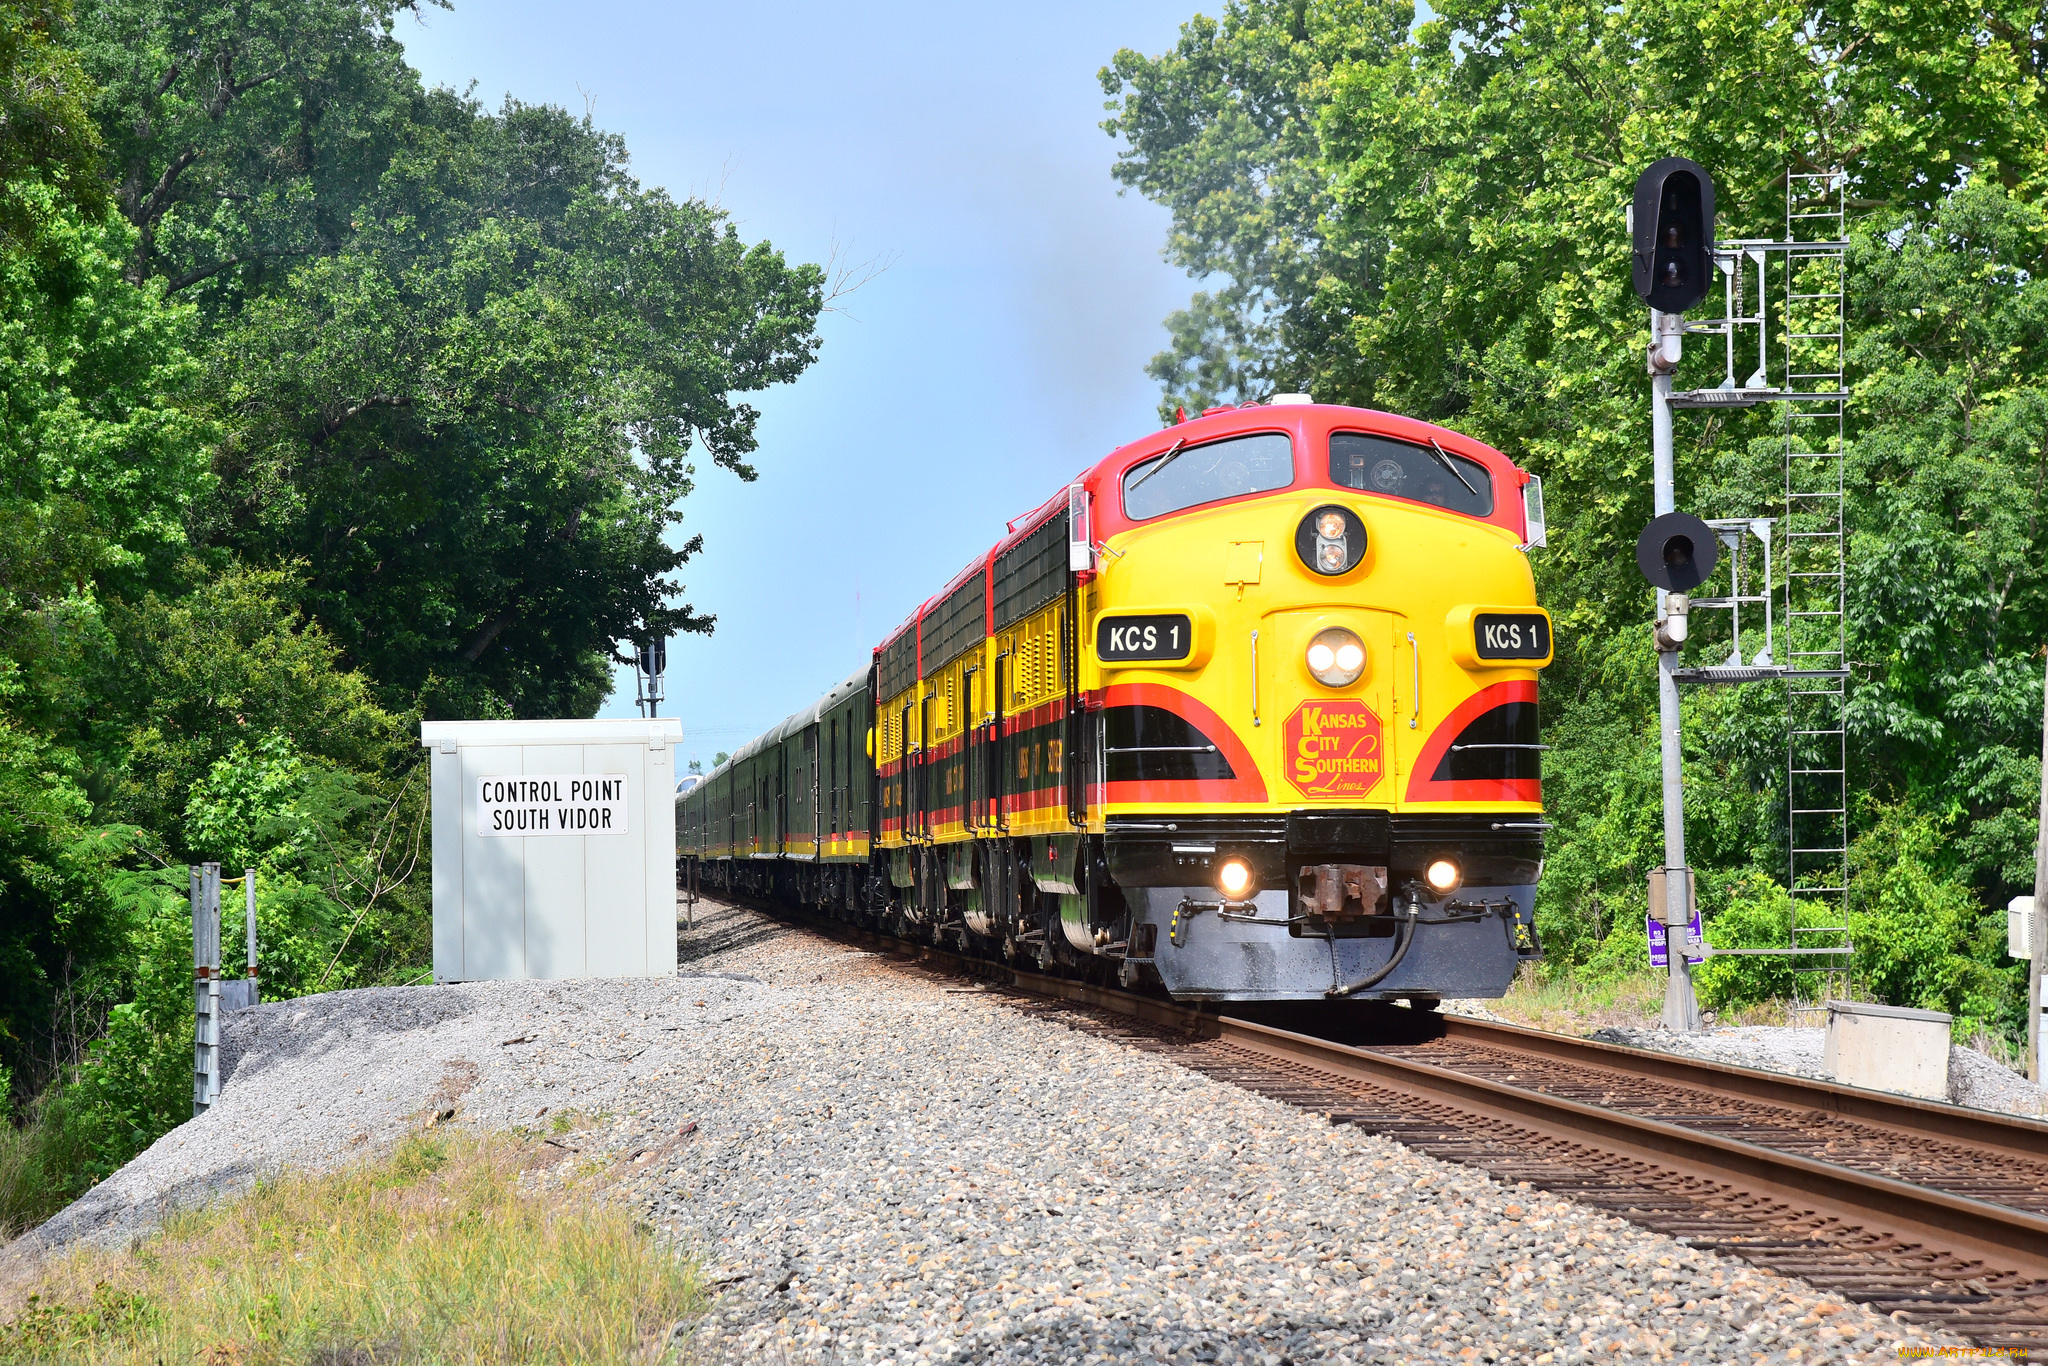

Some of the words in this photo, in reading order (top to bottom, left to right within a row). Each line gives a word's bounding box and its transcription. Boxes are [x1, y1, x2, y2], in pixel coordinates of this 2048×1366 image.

[1110, 625, 1157, 652] KCS
[1169, 625, 1179, 650] 1
[1484, 624, 1522, 649] KCS
[1529, 624, 1537, 648] 1
[1301, 707, 1367, 736] KANSAS
[1297, 736, 1340, 759] CITY
[1295, 756, 1379, 783] SOUTHERN
[482, 780, 563, 803] CONTROL
[571, 779, 623, 801] POINT
[493, 808, 549, 830] SOUTH
[558, 807, 612, 829] VIDOR
